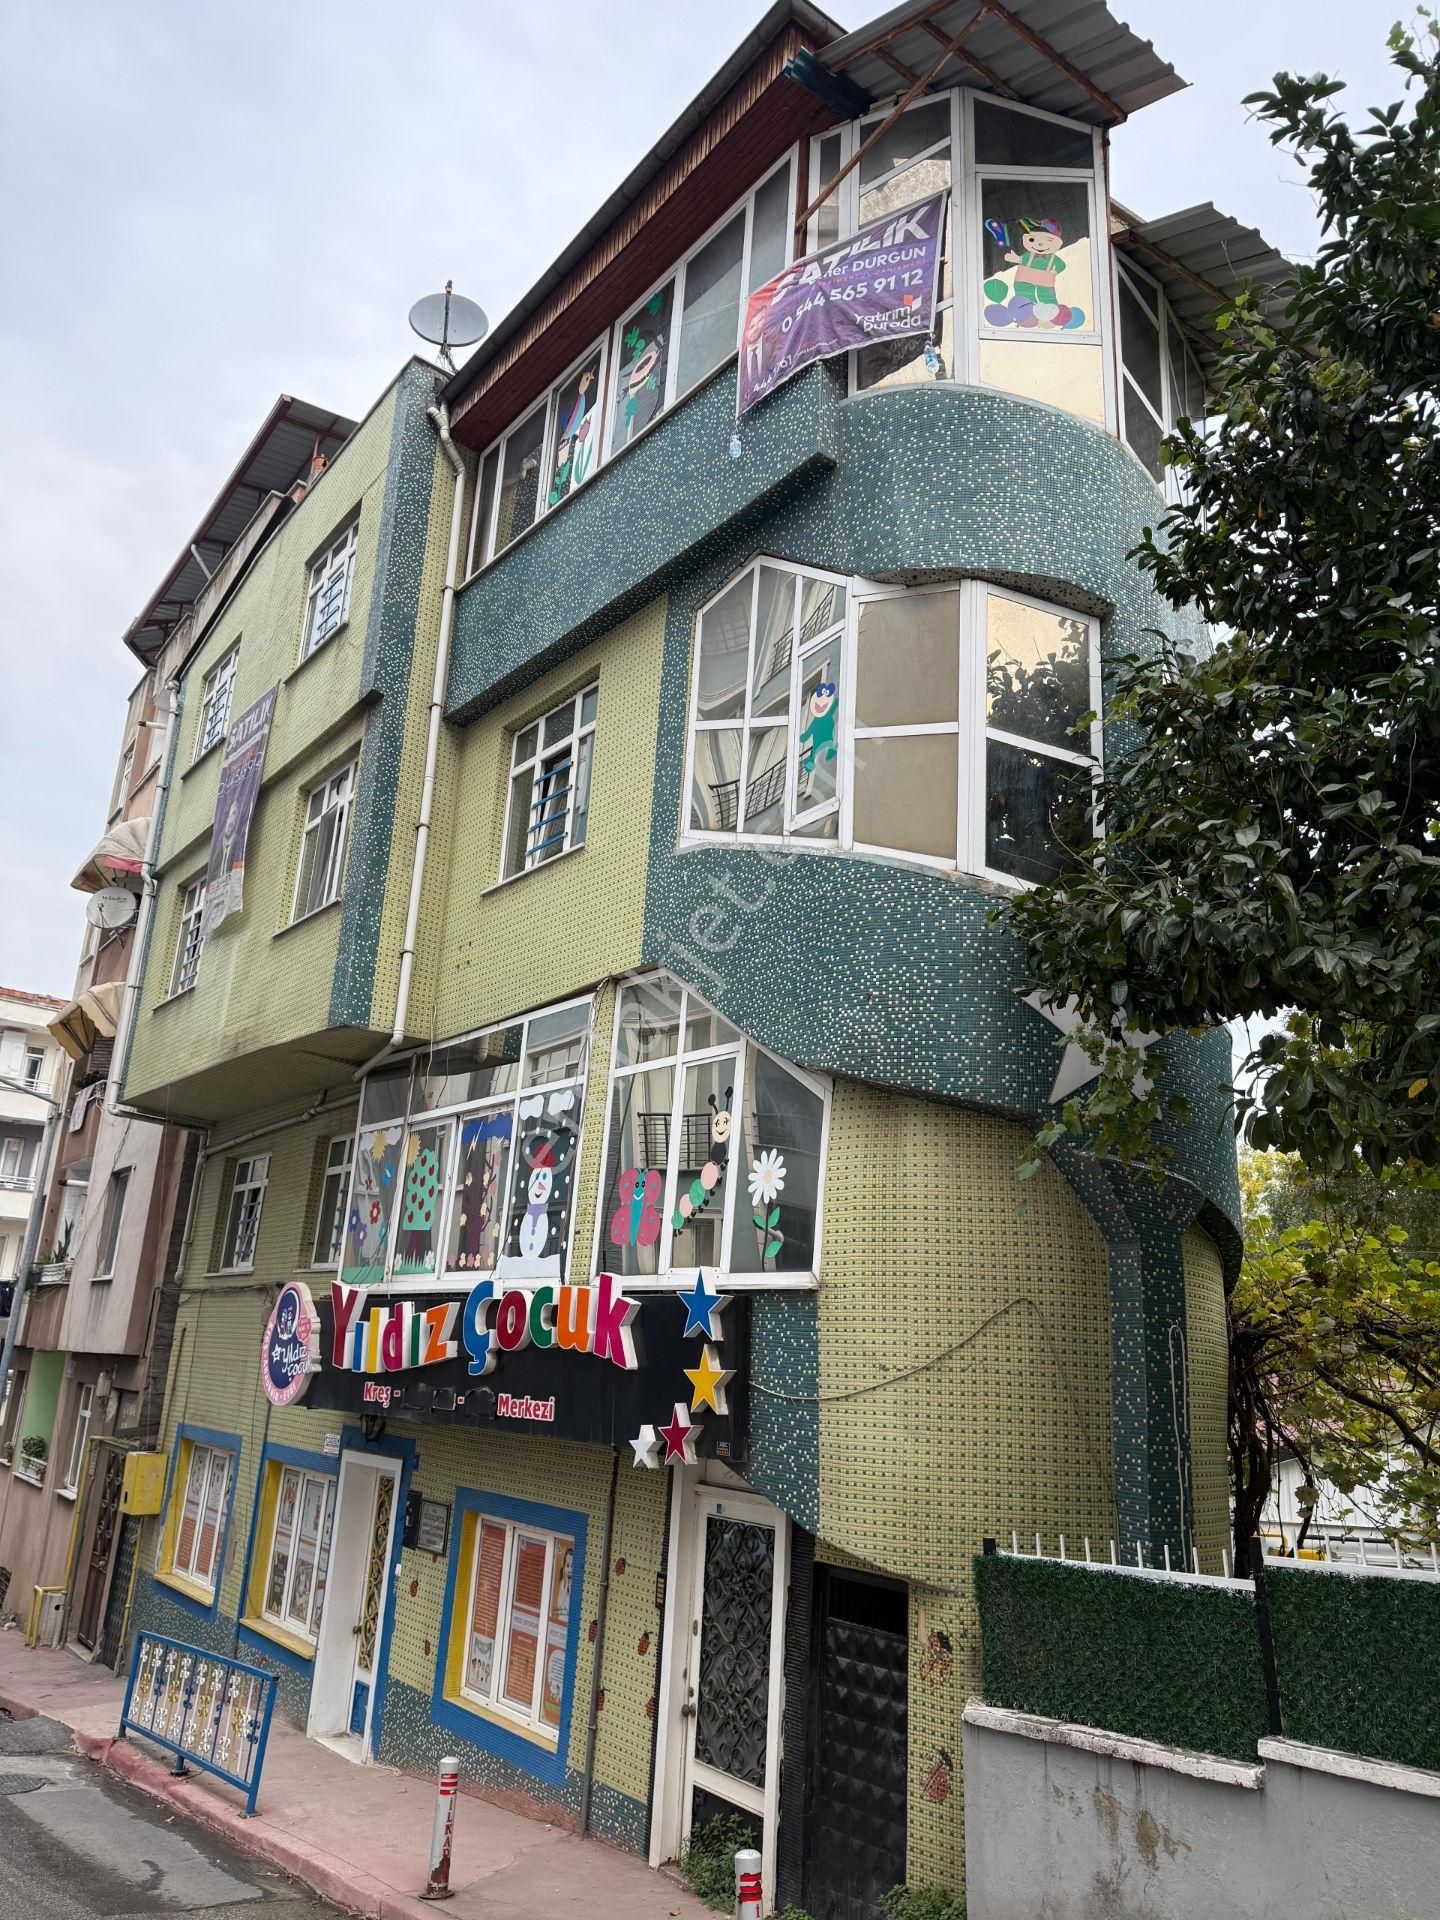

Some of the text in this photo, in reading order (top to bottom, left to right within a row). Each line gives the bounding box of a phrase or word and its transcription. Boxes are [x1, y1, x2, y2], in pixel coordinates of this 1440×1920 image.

[852, 246, 926, 273] DURGUN
[829, 281, 867, 301] 565
[901, 268, 924, 287] 12
[332, 1272, 641, 1376] Yıldız Çocuk
[364, 1382, 555, 1421] Kreş Merkezi
